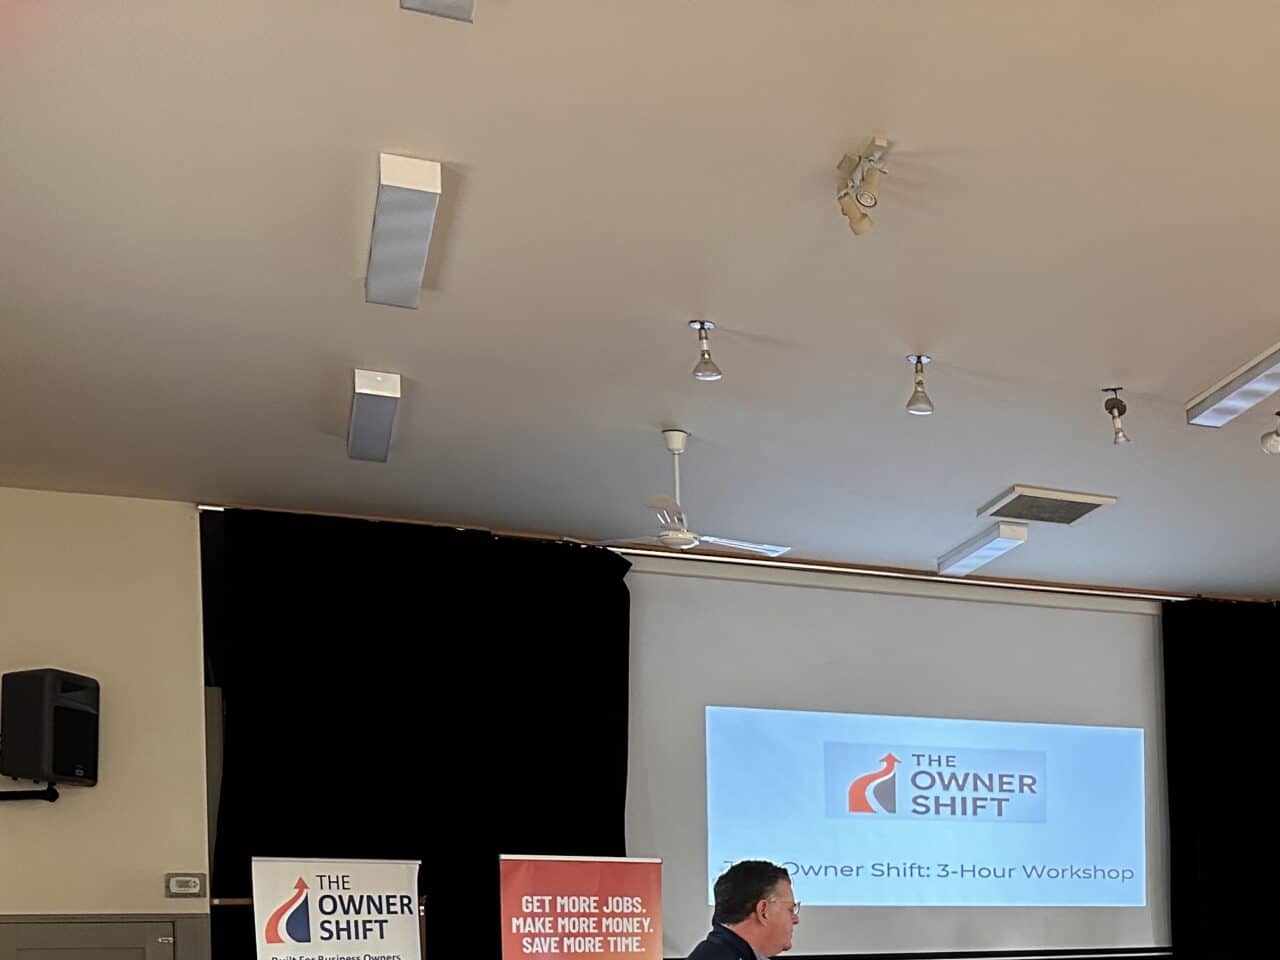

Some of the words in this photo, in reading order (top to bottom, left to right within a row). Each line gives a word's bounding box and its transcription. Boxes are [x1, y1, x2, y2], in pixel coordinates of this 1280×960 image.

[912, 754, 956, 767] THE
[911, 770, 1037, 794] OWNER
[911, 794, 1010, 817] SHIFT
[782, 862, 864, 877] Owner
[871, 862, 931, 878] Shift:
[936, 864, 1016, 879] 3-Hour
[1022, 864, 1135, 883] Workshop
[316, 875, 350, 890] THE
[319, 895, 414, 915] OWNER
[522, 896, 552, 913] GET
[556, 896, 599, 913] MORE
[603, 897, 647, 913] JOBS.
[320, 920, 388, 940] SHIFT
[512, 917, 554, 933] MAKE
[558, 917, 598, 933] MORE
[602, 917, 654, 933] MONEY.
[523, 937, 559, 953] SAVE
[564, 937, 604, 953] MORE
[608, 937, 645, 953] TIME.
